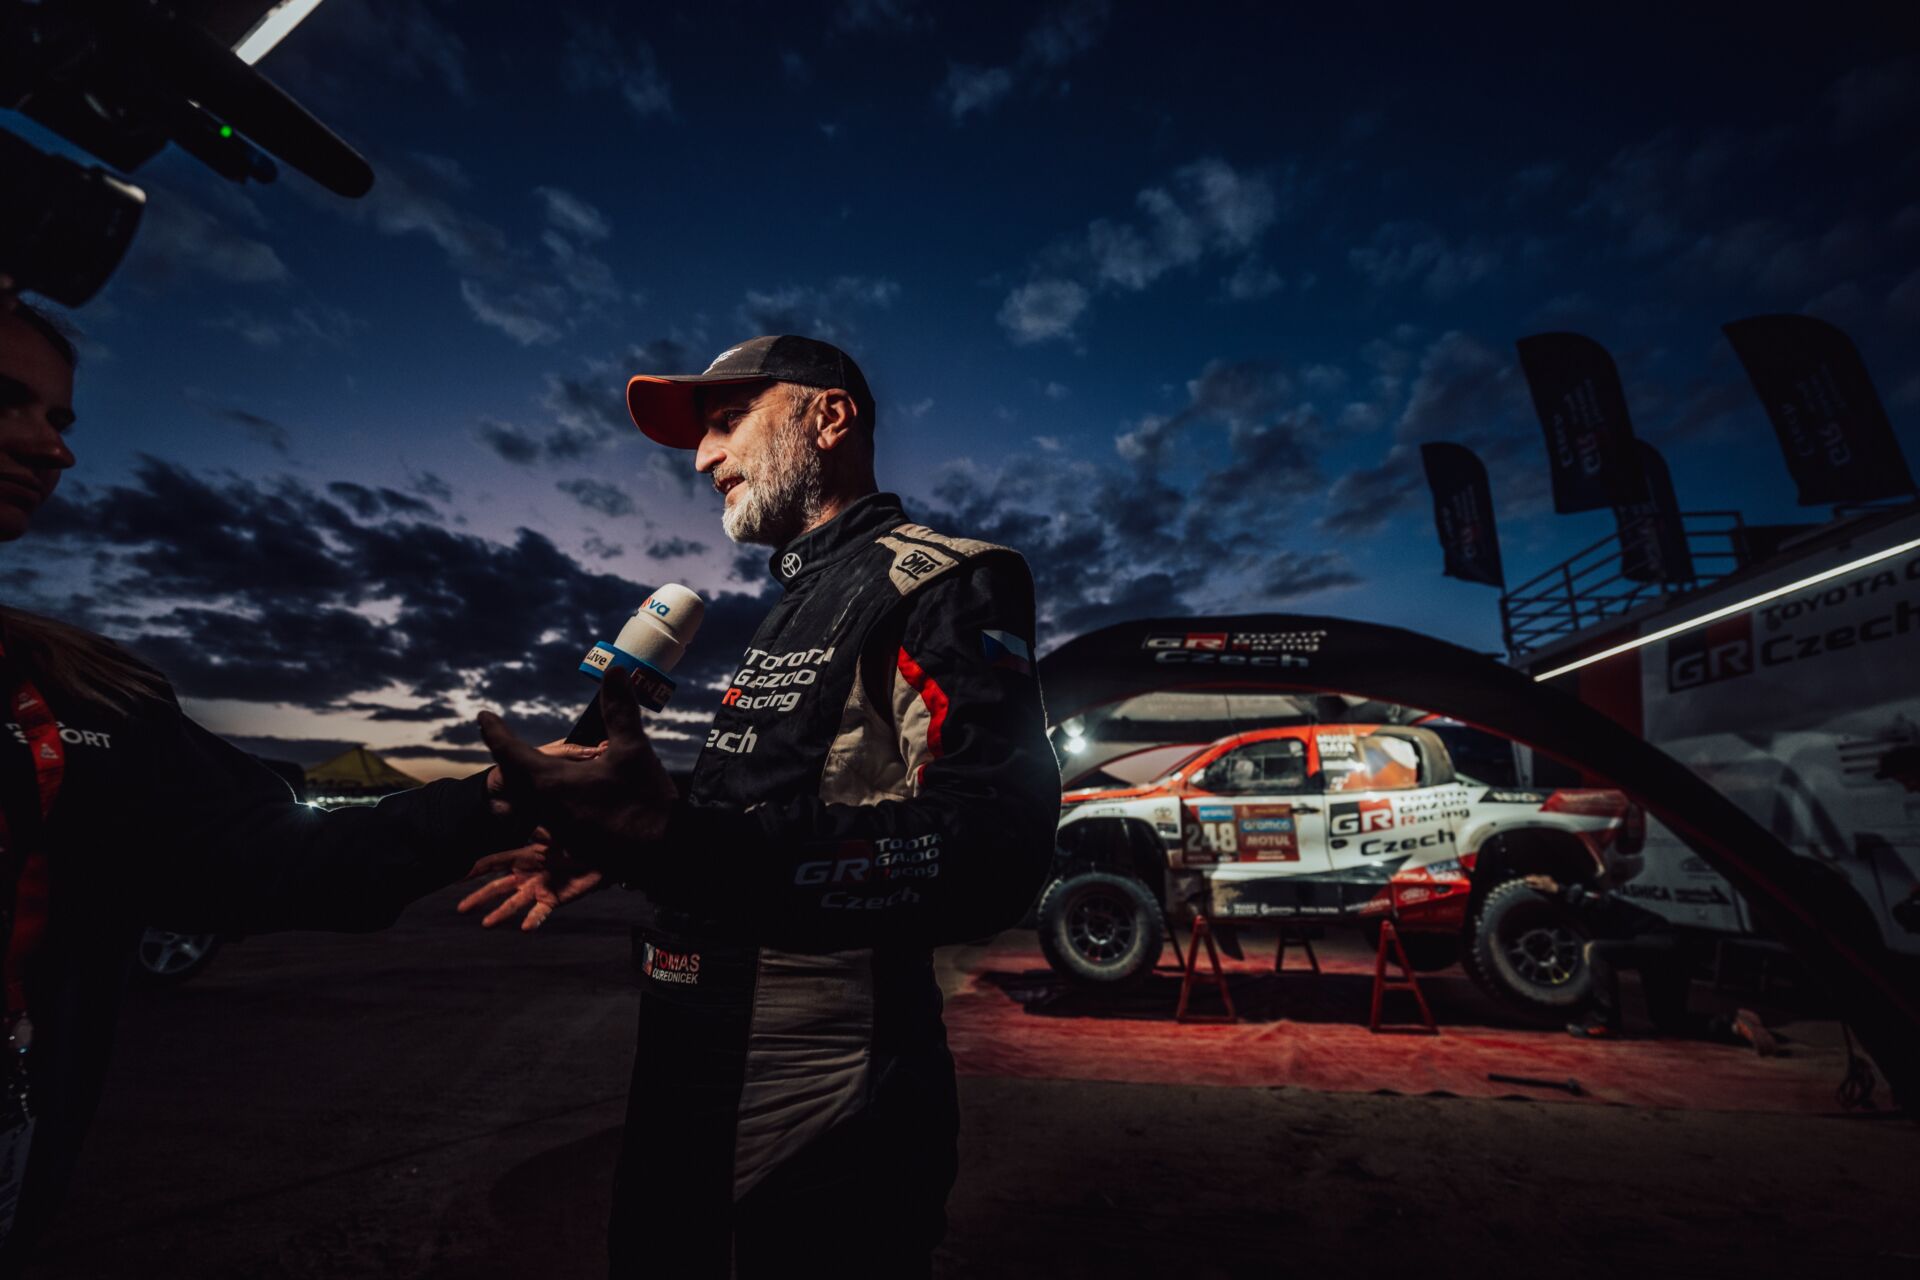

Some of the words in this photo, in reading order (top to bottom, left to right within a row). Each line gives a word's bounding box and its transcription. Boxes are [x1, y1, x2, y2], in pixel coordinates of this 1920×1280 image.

[1760, 571, 1898, 622] TOYOTA
[1761, 601, 1920, 668] Czech
[744, 647, 836, 671] TOYOTA
[1154, 650, 1310, 668] Czech
[1670, 640, 1752, 690] GR
[733, 668, 817, 688] GAZOO
[721, 686, 802, 712] Racing
[1243, 819, 1291, 832] aramco
[1331, 808, 1393, 836] GR
[1400, 809, 1470, 827] Racing
[1186, 822, 1237, 853] 248
[1245, 836, 1291, 848] MOTUL
[1360, 829, 1456, 856] Czech
[794, 856, 870, 886] GR
[819, 886, 921, 910] Czech
[655, 947, 701, 973] TOMAS
